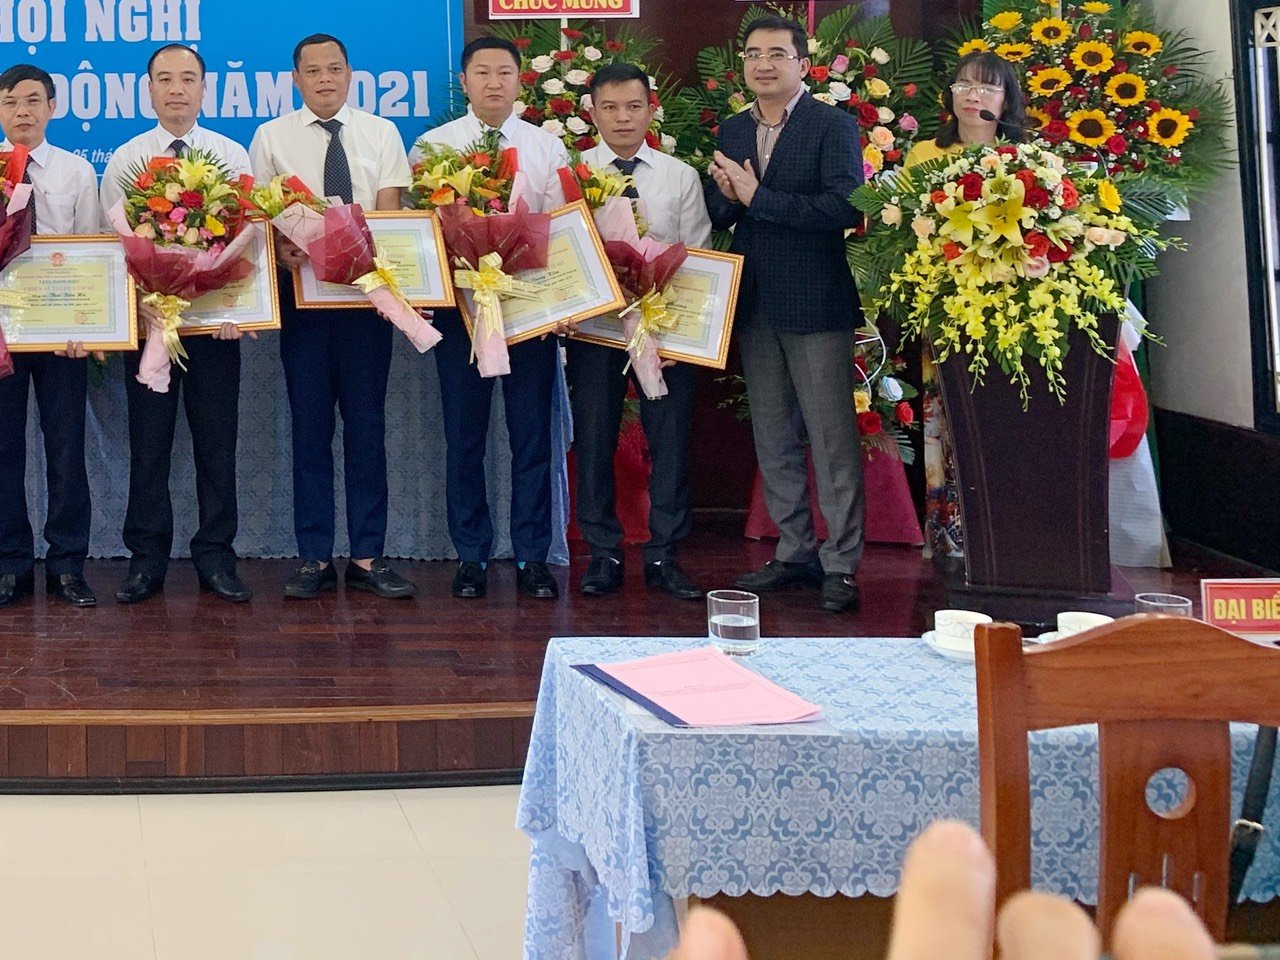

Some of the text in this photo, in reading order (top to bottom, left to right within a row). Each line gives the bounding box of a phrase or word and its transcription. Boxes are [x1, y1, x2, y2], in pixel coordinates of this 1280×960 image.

[347, 70, 430, 117] 021
[90, 147, 114, 163] thá
[1214, 590, 1280, 625] ĐẠI BIỂ
